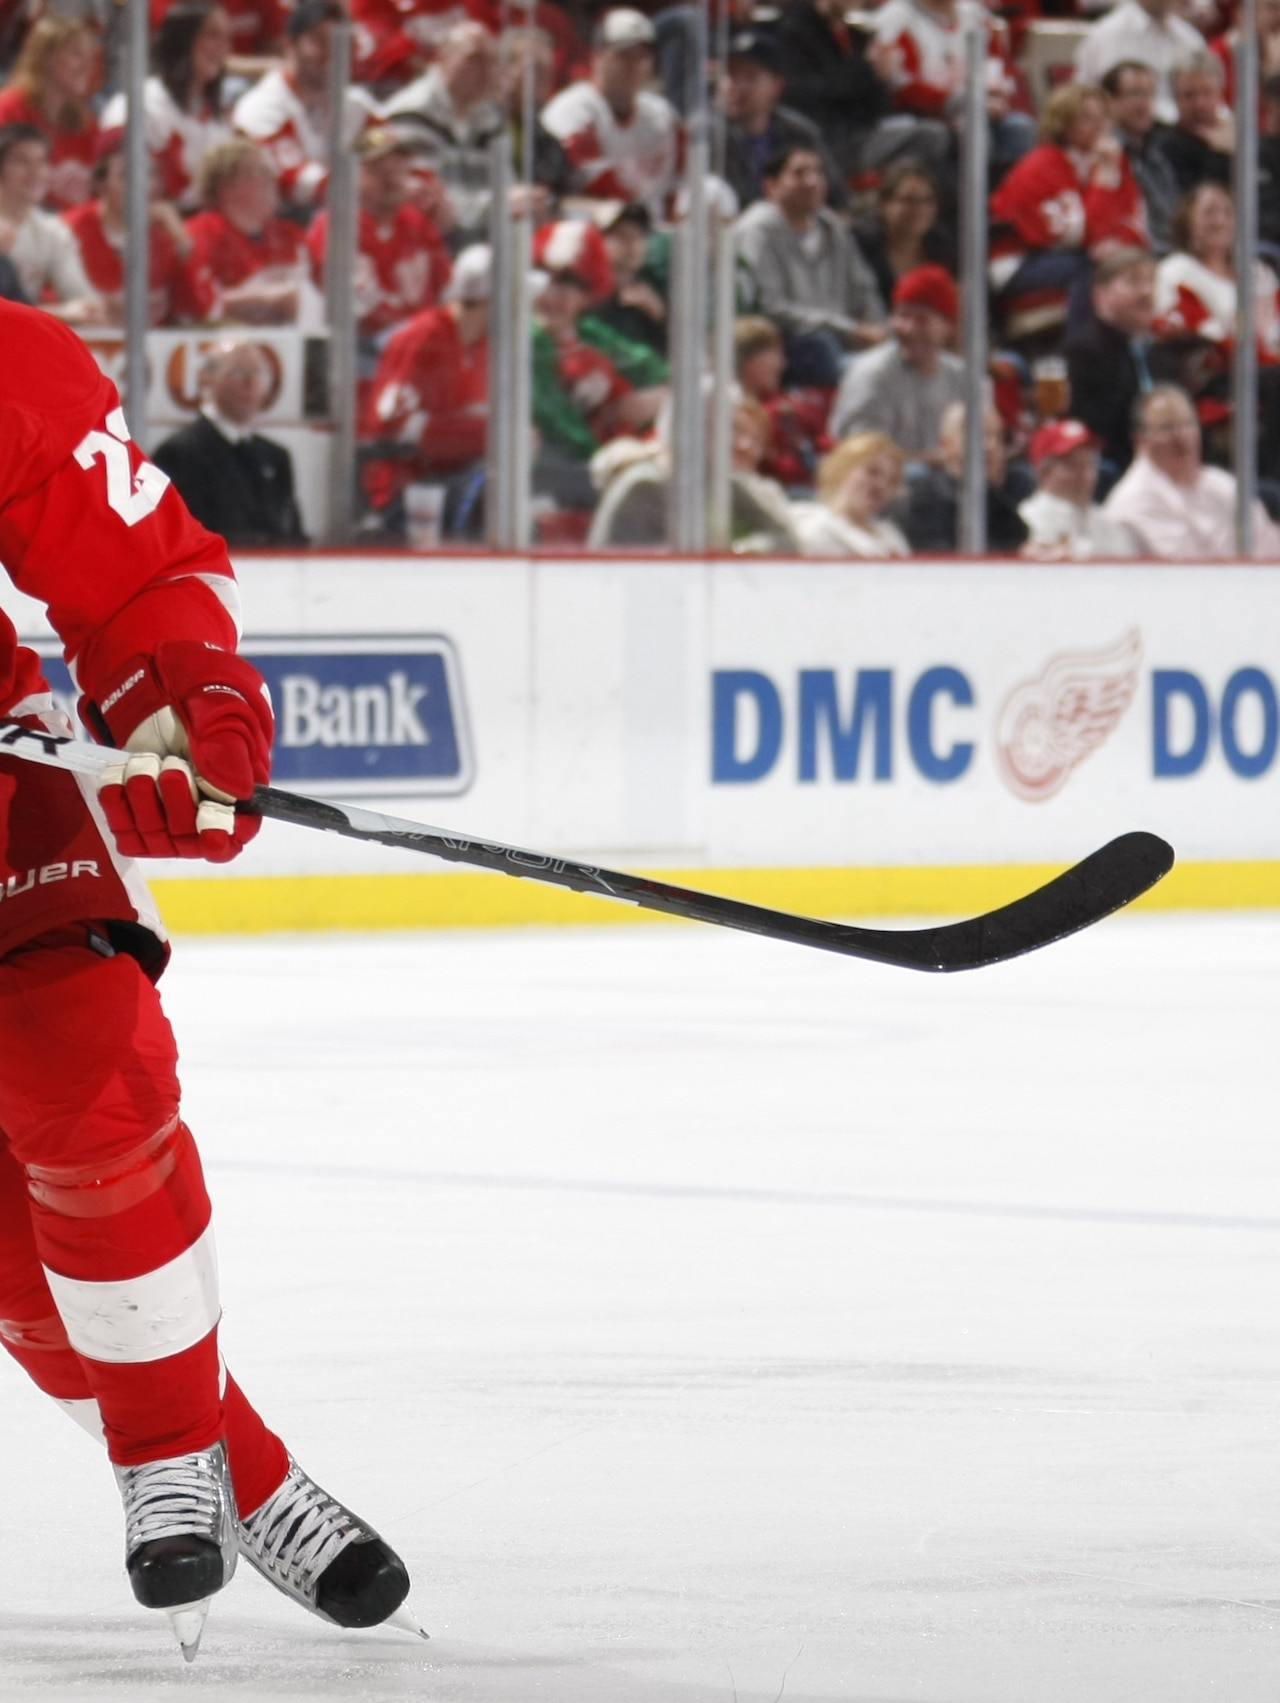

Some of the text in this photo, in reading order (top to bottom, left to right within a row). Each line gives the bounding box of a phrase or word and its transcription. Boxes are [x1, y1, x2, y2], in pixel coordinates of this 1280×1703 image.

[281, 671, 430, 747] Bank
[711, 664, 1280, 785] DMC DO
